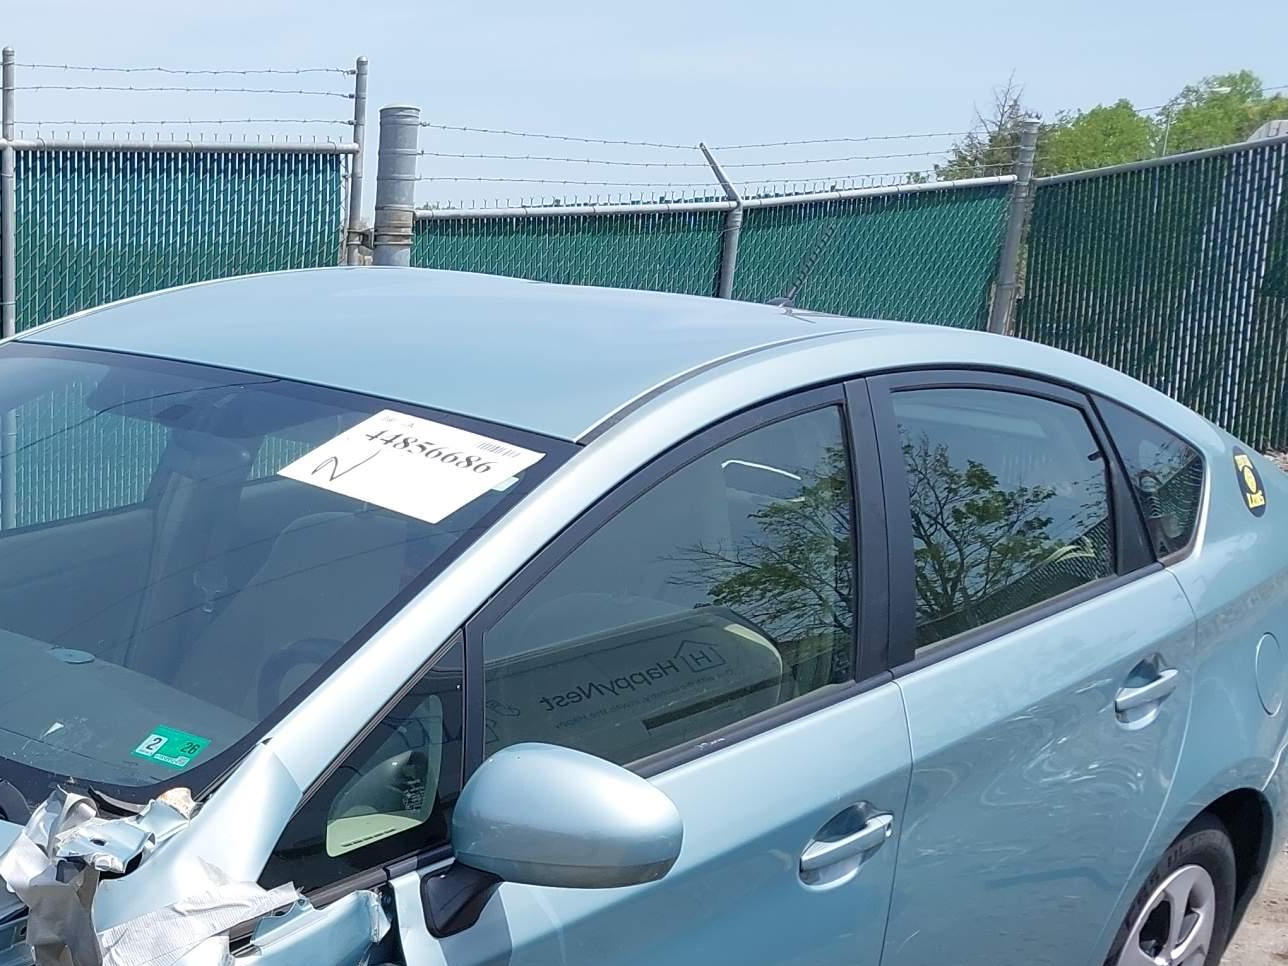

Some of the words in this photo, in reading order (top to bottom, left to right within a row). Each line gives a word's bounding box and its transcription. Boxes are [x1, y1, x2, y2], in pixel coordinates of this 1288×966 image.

[365, 430, 497, 473] 44856686
[146, 738, 162, 750] 2
[181, 743, 200, 754] 26
